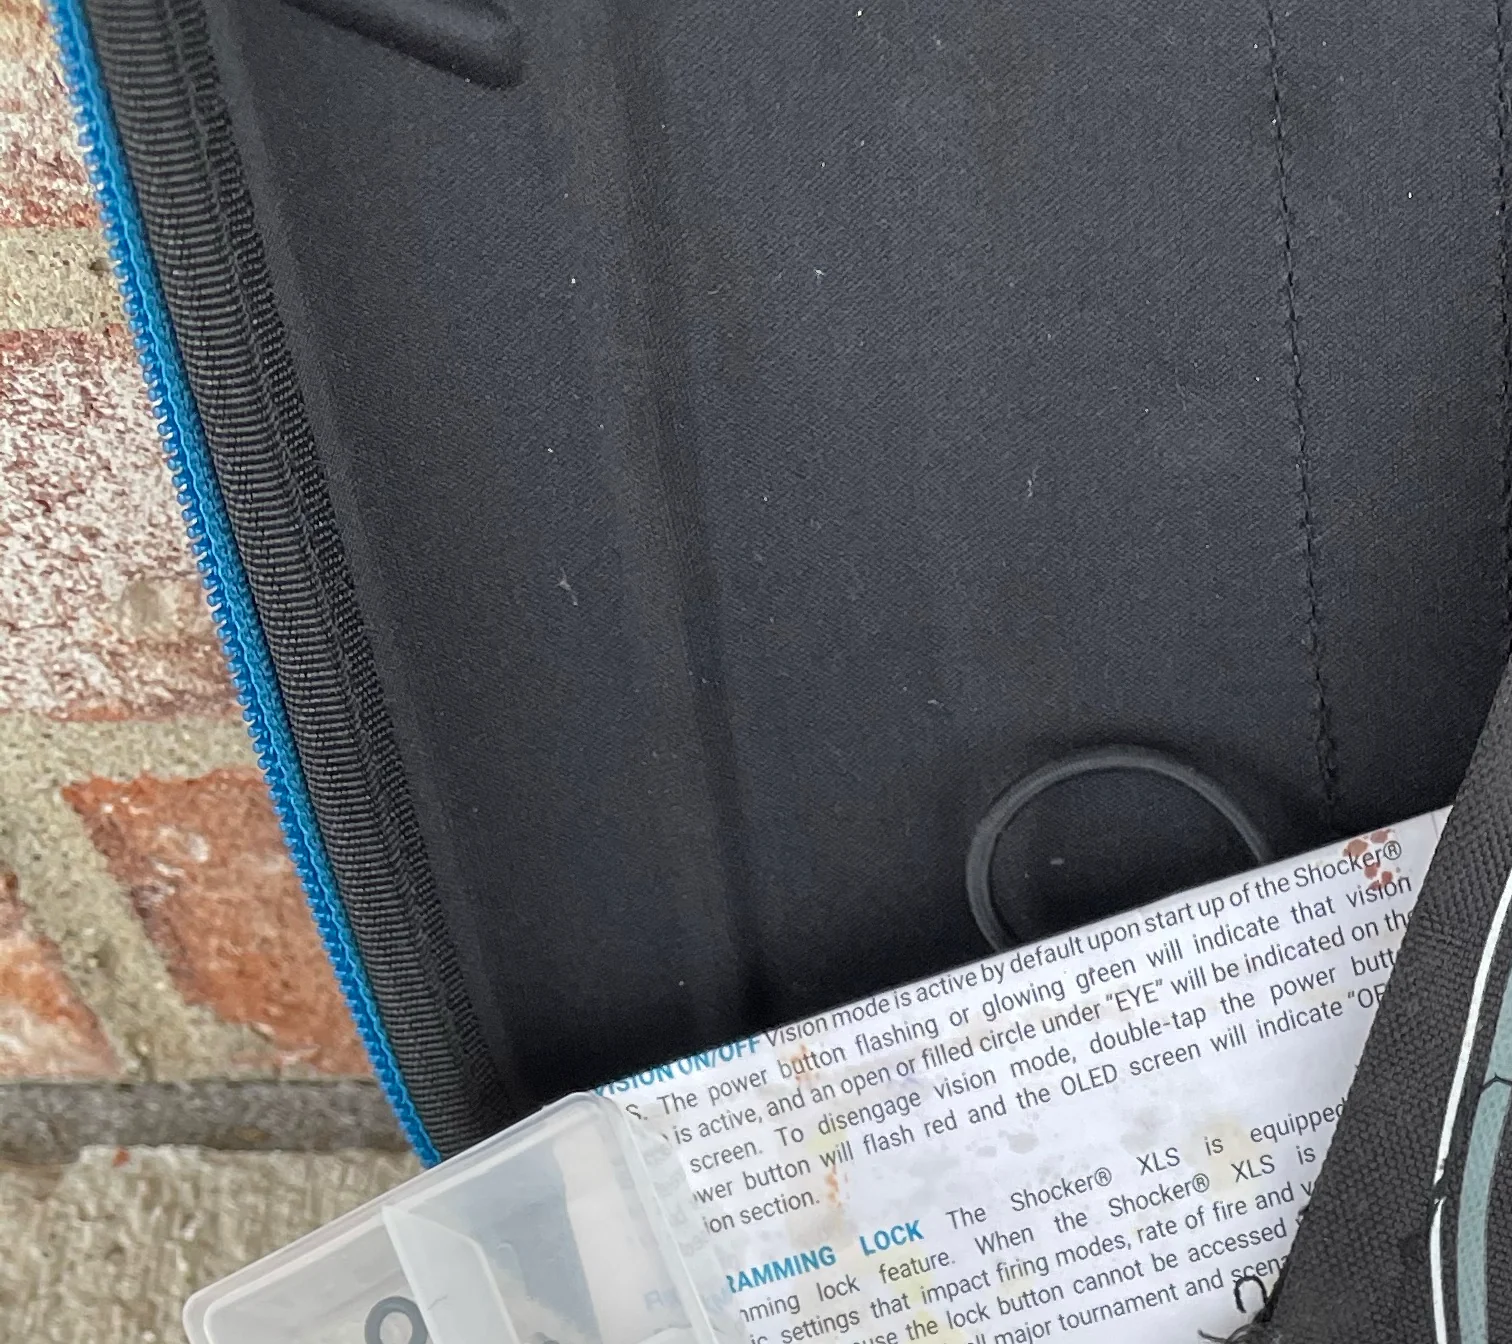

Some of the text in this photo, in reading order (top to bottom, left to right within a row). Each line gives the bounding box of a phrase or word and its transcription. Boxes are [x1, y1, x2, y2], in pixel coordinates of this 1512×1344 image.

[656, 1093, 698, 1114] The
[708, 1069, 767, 1106] power
[777, 1047, 847, 1081] button
[855, 1018, 939, 1056] flashing
[949, 1007, 969, 1026] or
[983, 971, 1066, 1022] glowing
[1076, 959, 1136, 994] green
[1146, 938, 1183, 967] will
[1193, 916, 1280, 954] indicate
[1290, 896, 1336, 924] that
[1346, 871, 1412, 907] vision
[673, 1126, 692, 1144] is
[698, 1108, 762, 1137] active,
[767, 1087, 805, 1116] and
[811, 1084, 836, 1103] an
[841, 1067, 891, 1096] open
[896, 1058, 915, 1076] or
[922, 1036, 974, 1070] filled
[980, 1021, 1036, 1052] circle
[1041, 1003, 1100, 1033] under
[1170, 966, 1207, 995] will
[1211, 963, 1239, 983] be
[1244, 925, 1345, 973] indicated
[1352, 922, 1379, 941] on
[765, 1016, 827, 1048] Vision
[832, 998, 890, 1028] mode
[894, 992, 912, 1009] is
[916, 972, 977, 1002] active
[981, 962, 1004, 984] by
[1010, 937, 1084, 973] default
[1087, 923, 1141, 952] upon
[1145, 903, 1195, 932] start
[1197, 897, 1224, 918] up
[1230, 882, 1250, 906] of
[1255, 877, 1290, 899] the
[690, 1142, 763, 1173] screen.
[774, 1127, 804, 1146] To
[818, 1092, 921, 1135] disengage
[933, 1070, 996, 1099] vision
[1010, 1045, 1076, 1078] mode,
[1090, 1007, 1206, 1054] double-tap
[1220, 992, 1255, 1014] the
[1270, 967, 1335, 1006] power
[693, 1181, 732, 1203] wer
[742, 1160, 811, 1190] button
[819, 1141, 854, 1174] will
[863, 1125, 915, 1155] flash
[924, 1109, 957, 1137] red
[968, 1094, 1007, 1124] and
[1016, 1088, 1051, 1109] the
[1061, 1064, 1117, 1095] OLED
[1130, 1044, 1201, 1076] screen
[1210, 1023, 1247, 1052] will
[1256, 1001, 1343, 1039] indicate
[740, 1192, 820, 1224] section.
[781, 1311, 860, 1344] settings
[870, 1293, 911, 1318] that
[920, 1270, 991, 1304] impact
[996, 1256, 1049, 1283] firing
[1055, 1235, 1131, 1267] modes,
[1137, 1220, 1178, 1244] rate
[1185, 1205, 1205, 1229] of
[1213, 1201, 1247, 1222] fire
[1255, 1181, 1294, 1210] and
[816, 1274, 860, 1301] lock
[879, 1252, 955, 1284] feature.
[974, 1228, 1034, 1255] When
[1054, 1212, 1088, 1233] the
[1109, 1173, 1209, 1217] Shocker®
[1231, 1154, 1275, 1183] XLS
[1296, 1145, 1316, 1165] is
[859, 1220, 924, 1256] LOCK
[945, 1207, 986, 1229] The
[1011, 1167, 1112, 1211] Shocker®
[1136, 1147, 1180, 1176] XLS
[1204, 1136, 1223, 1156] is
[905, 1320, 938, 1340] the
[946, 1302, 991, 1329] lock
[997, 1285, 1064, 1315] button
[1073, 1260, 1144, 1294] cannot
[1150, 1253, 1178, 1272] be
[1188, 1217, 1287, 1262] accessed
[1058, 1284, 1179, 1331] tournament
[1185, 1268, 1224, 1296] and
